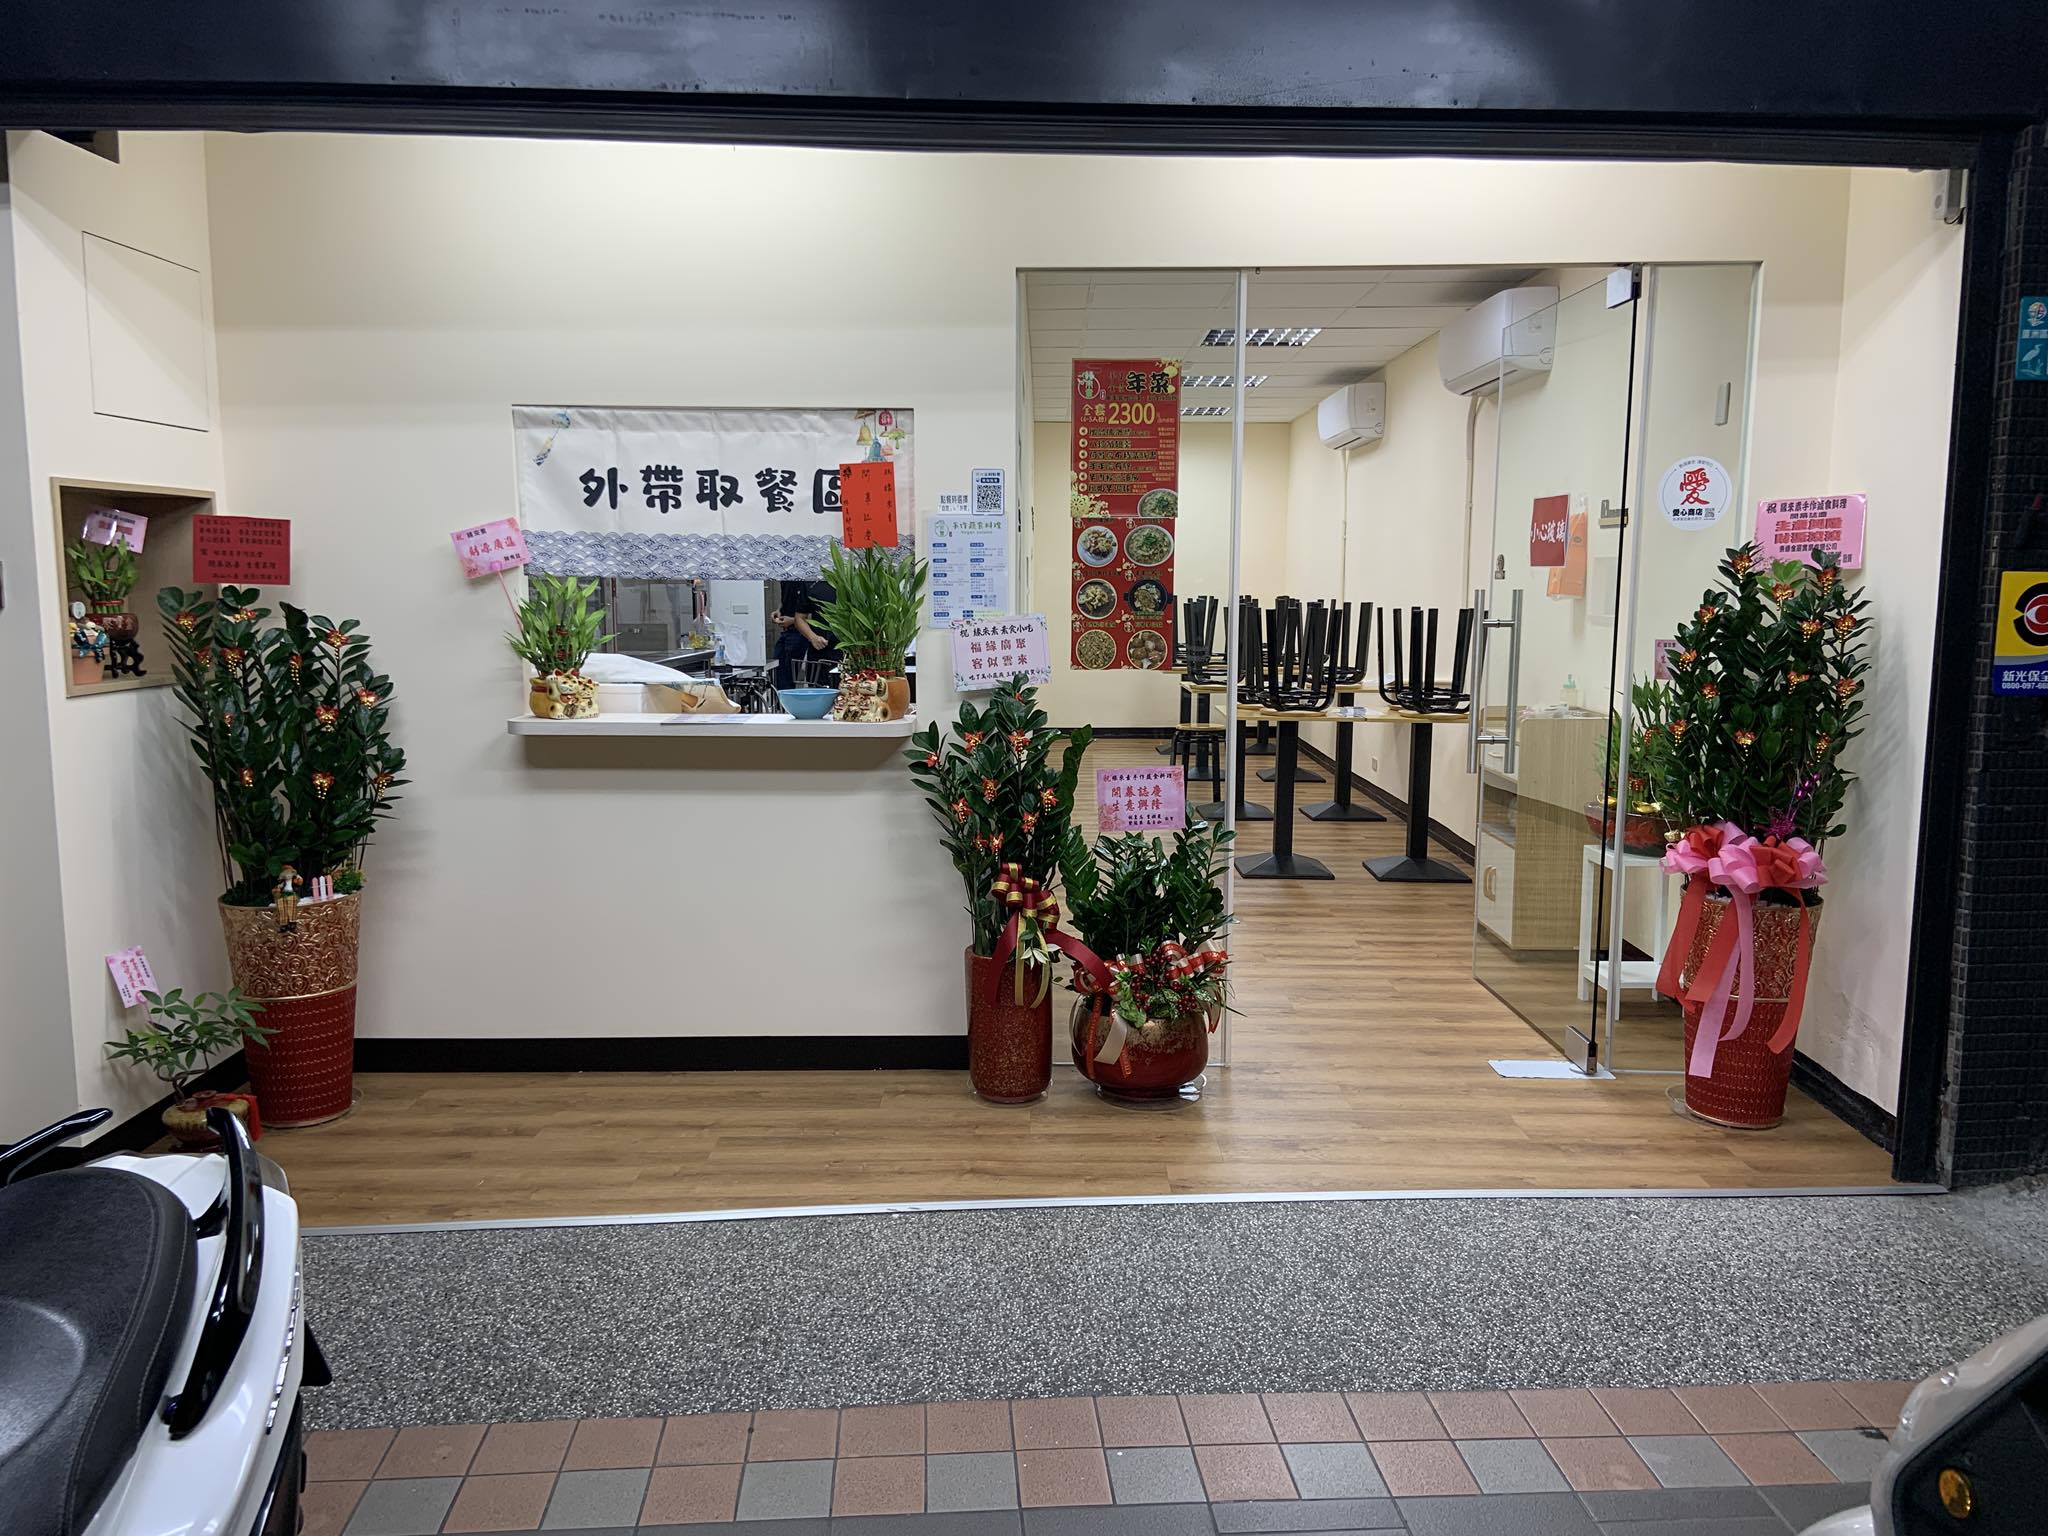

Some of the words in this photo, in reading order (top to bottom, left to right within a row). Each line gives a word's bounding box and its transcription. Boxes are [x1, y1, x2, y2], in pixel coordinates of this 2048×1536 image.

[1126, 370, 1170, 394] 年菜
[1107, 402, 1156, 425] 2300
[1672, 508, 1703, 517] 愛心商店
[1766, 502, 1777, 514] 祝
[1529, 516, 1567, 543] 小心玻璃
[960, 629, 970, 638] 祝
[971, 653, 1028, 670] 客似雲來
[2001, 670, 2048, 682] 新光保全
[1111, 784, 1162, 798] 開幕誌慶
[1112, 799, 1163, 813] 生意興隆
